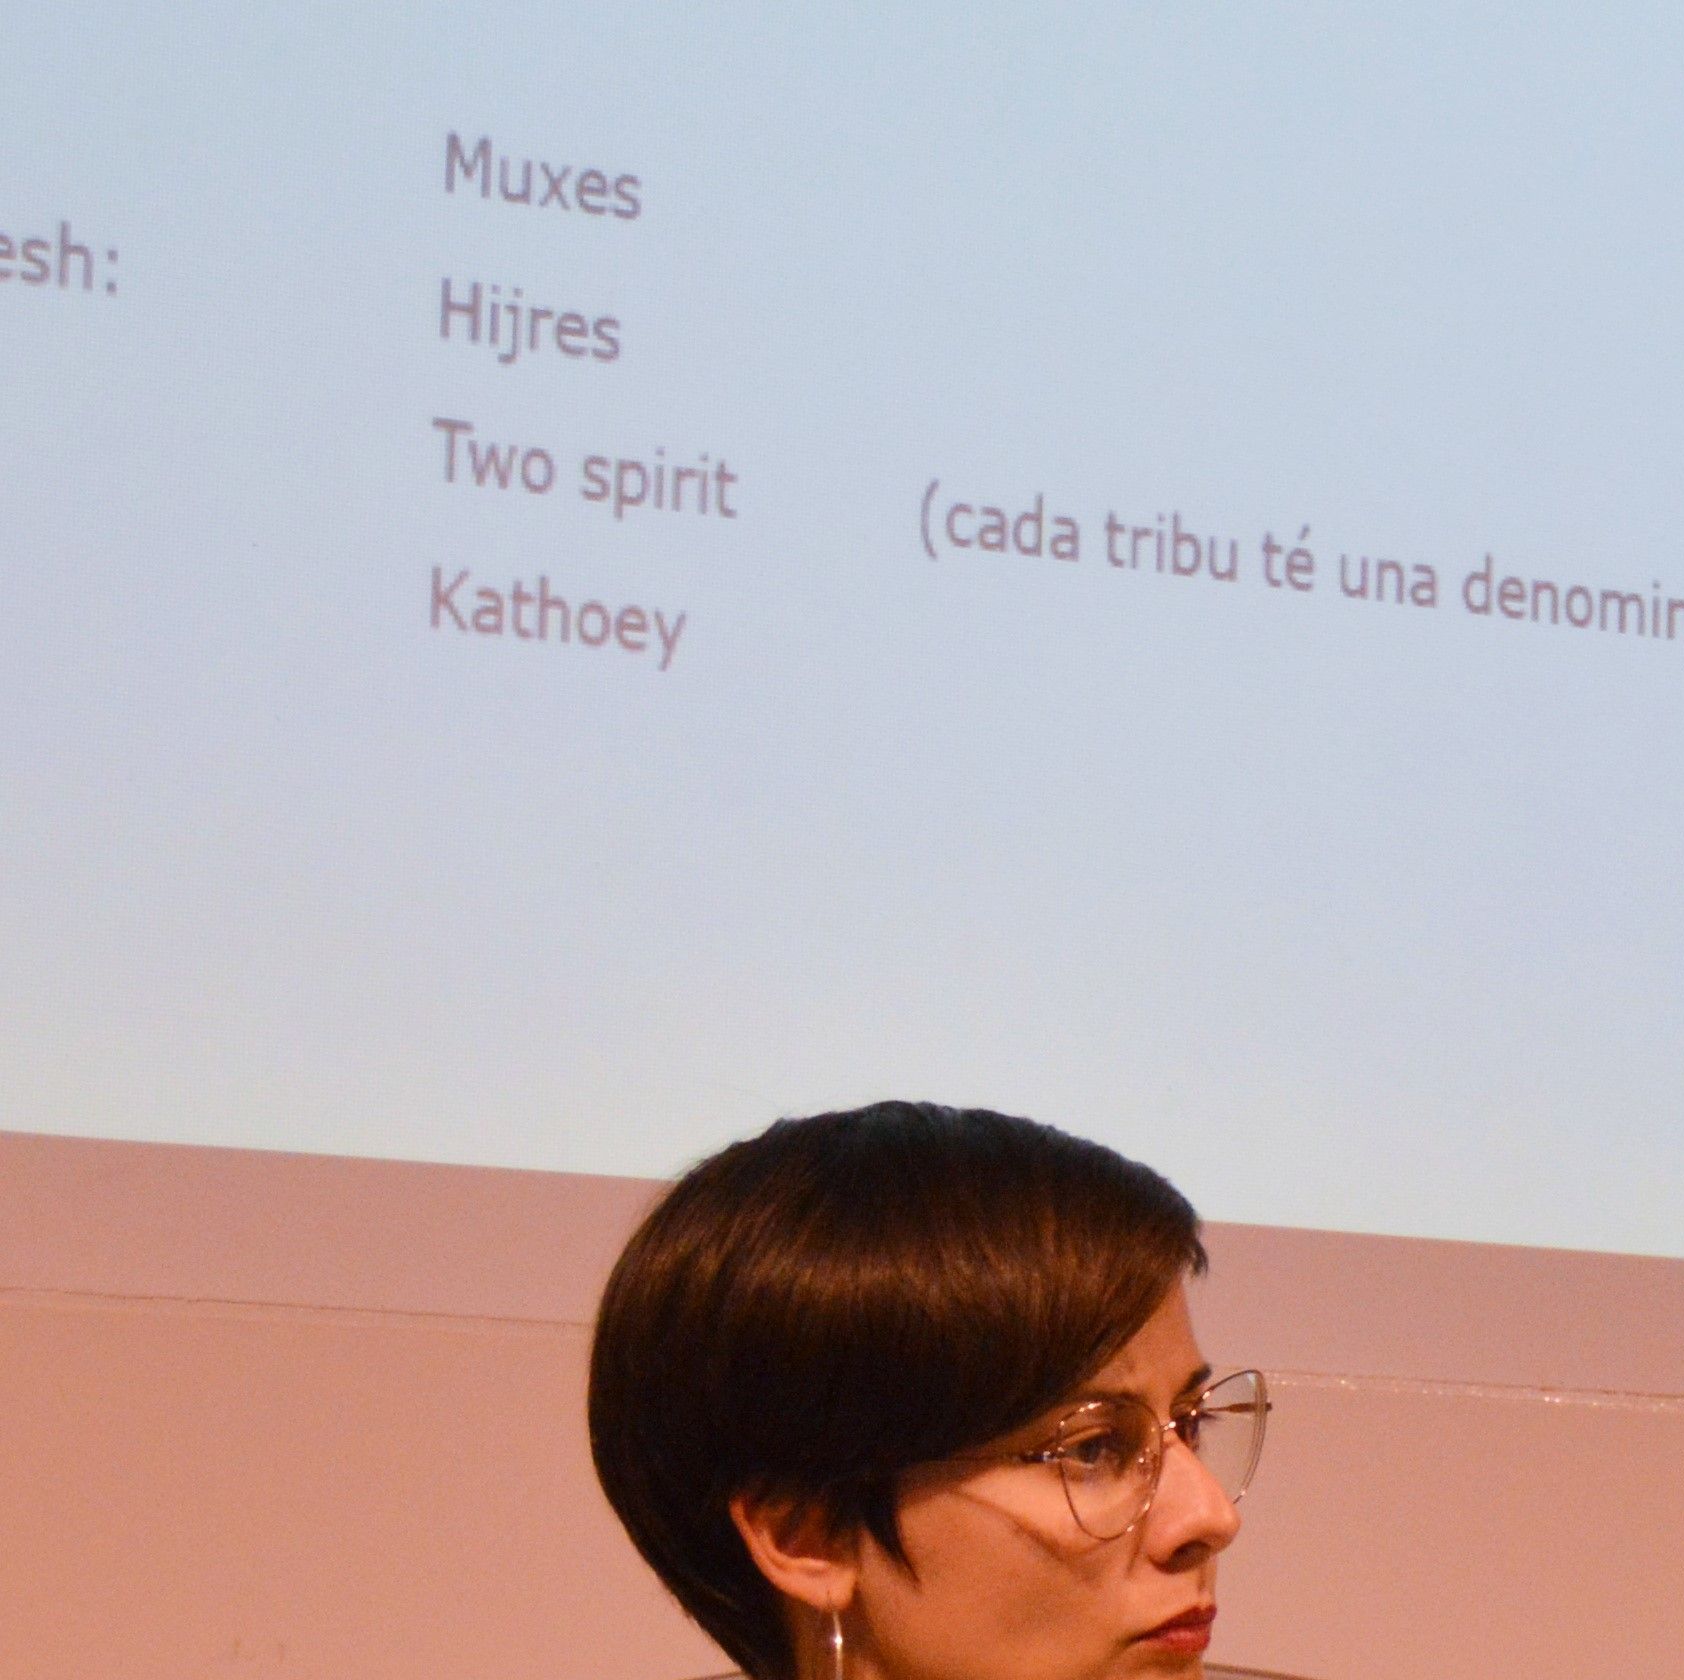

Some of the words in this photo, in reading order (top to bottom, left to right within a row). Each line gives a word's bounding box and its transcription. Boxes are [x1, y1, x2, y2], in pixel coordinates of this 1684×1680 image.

[445, 132, 641, 220] Muxes
[440, 278, 621, 365] Hijres
[432, 417, 555, 495] Two
[581, 448, 737, 519] spirit
[921, 480, 1080, 561] (cada
[1104, 511, 1238, 582] tribu
[1261, 526, 1314, 592] té
[1340, 556, 1438, 607] una
[430, 566, 686, 671] Kathoey
